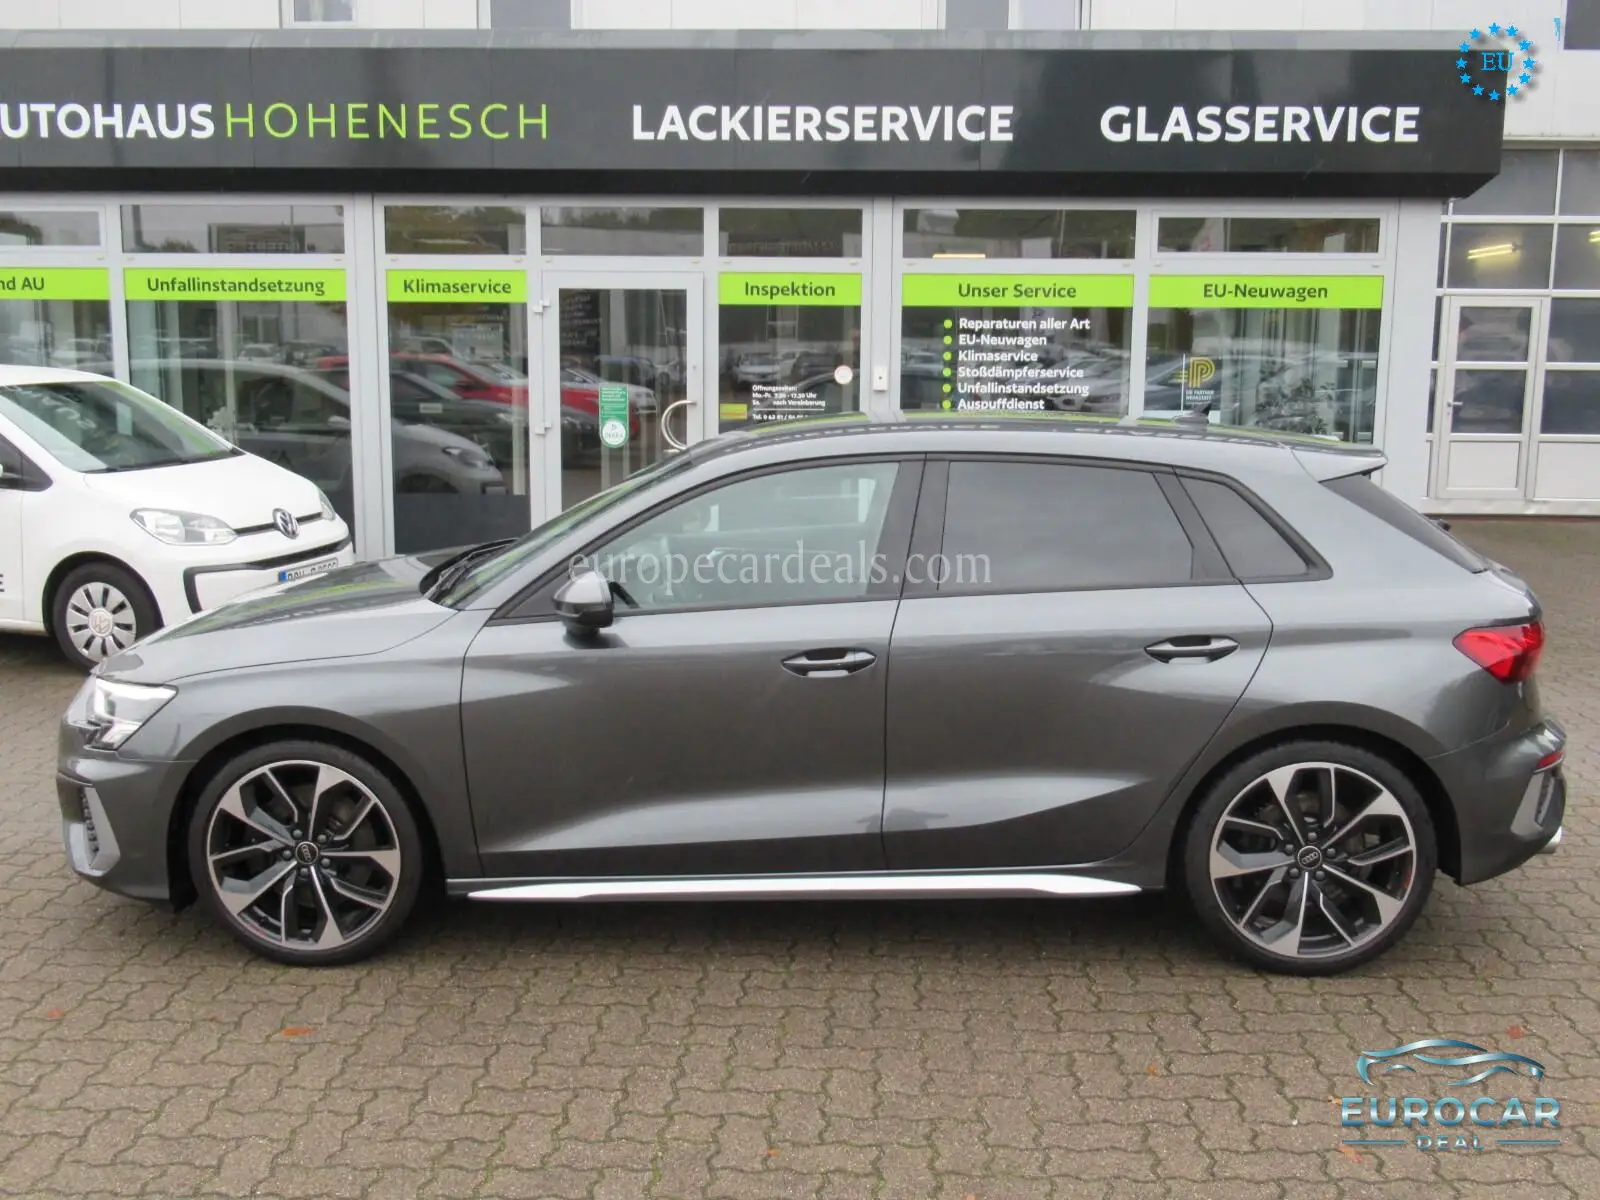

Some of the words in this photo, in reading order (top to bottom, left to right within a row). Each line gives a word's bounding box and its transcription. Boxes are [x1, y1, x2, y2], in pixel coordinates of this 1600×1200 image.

[225, 102, 549, 139] HOHENESCH
[632, 104, 1014, 142] LACKIERSERVICE
[1100, 105, 1420, 143] GLASSERVICE
[22, 277, 45, 291] AU
[147, 277, 325, 296] Unfallinstandsetzung
[403, 279, 512, 295] Klimaservice
[745, 282, 835, 298] Inspektion
[958, 283, 1008, 298] Unser
[1013, 283, 1077, 299] Service
[1203, 284, 1328, 302] EU-Neuwagen
[959, 318, 1037, 331] Reparaturen
[1039, 318, 1067, 329] aller
[1070, 318, 1091, 329] Art
[958, 334, 1047, 347] EU-Neuwagen
[958, 350, 1038, 362] Klimaservice
[958, 366, 1084, 379] Stoßdämpferservice
[958, 383, 1089, 396] Unfallinstandsetzung
[957, 399, 1045, 410] Auspuffdienst
